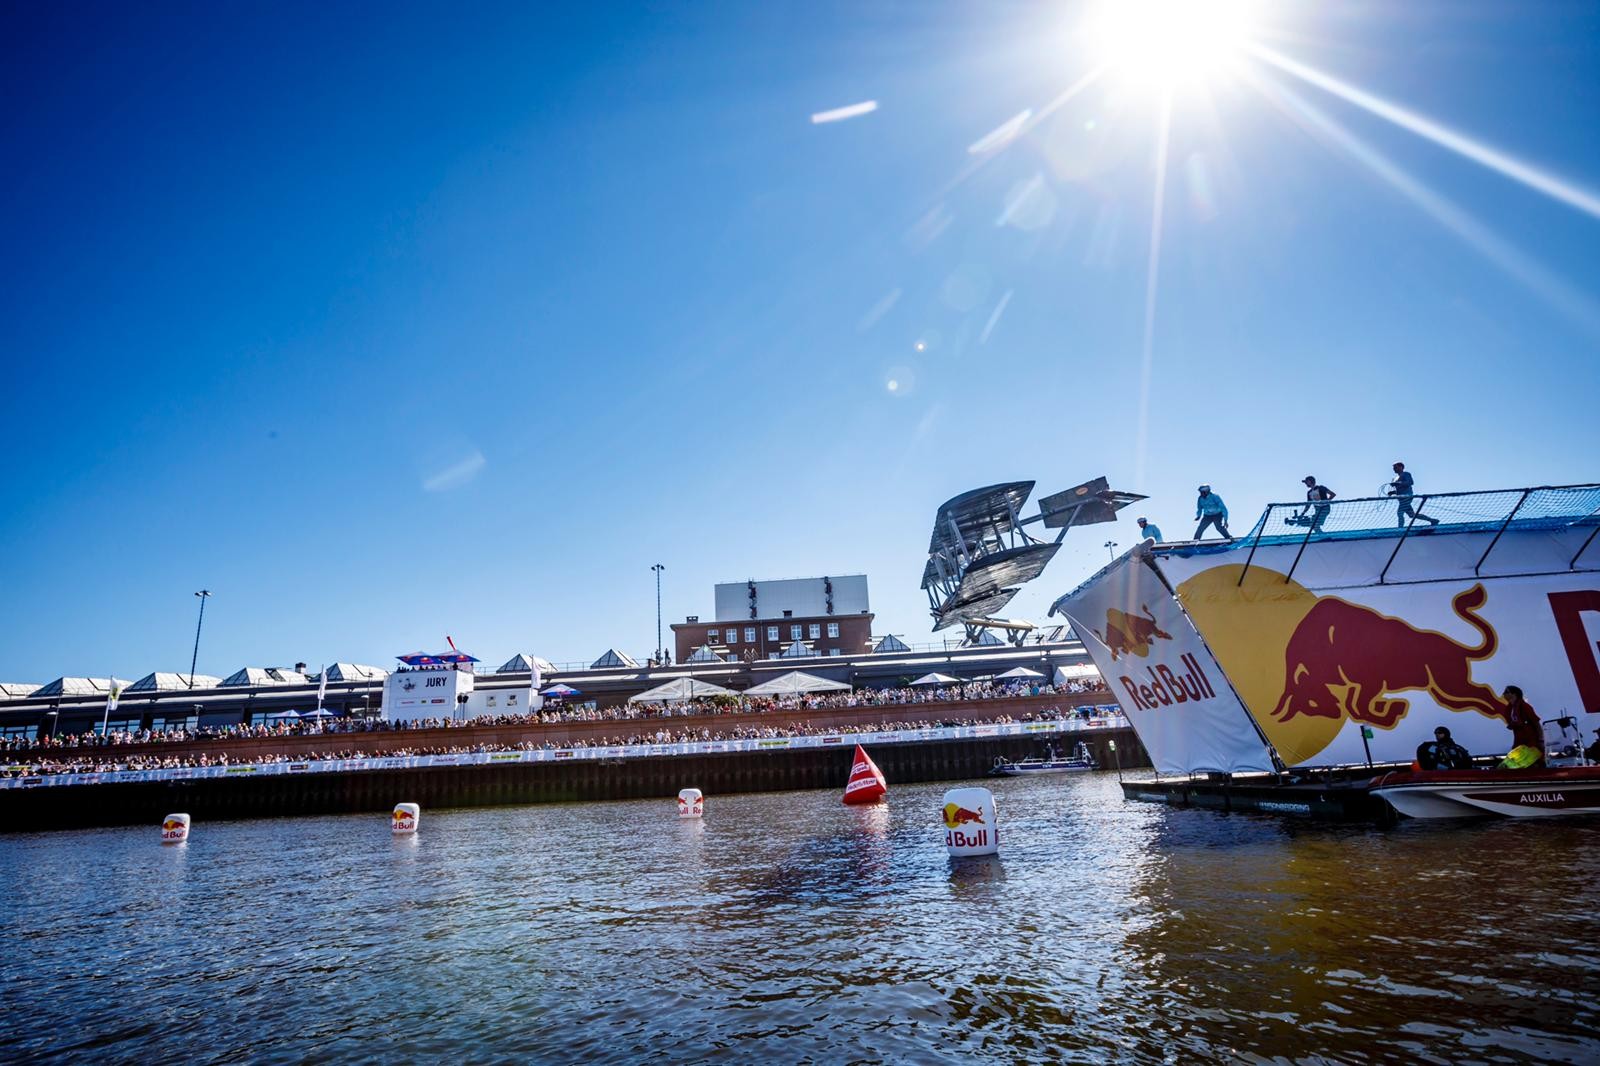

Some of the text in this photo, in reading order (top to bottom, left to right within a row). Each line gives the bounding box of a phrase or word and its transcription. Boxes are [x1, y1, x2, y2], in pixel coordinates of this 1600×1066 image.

[425, 677, 447, 688] JURY
[1119, 652, 1216, 711] Red Bull
[1520, 793, 1565, 803] AUXILIA
[398, 820, 415, 830] Bull
[169, 830, 186, 839] Bull
[954, 830, 987, 847] Bull
